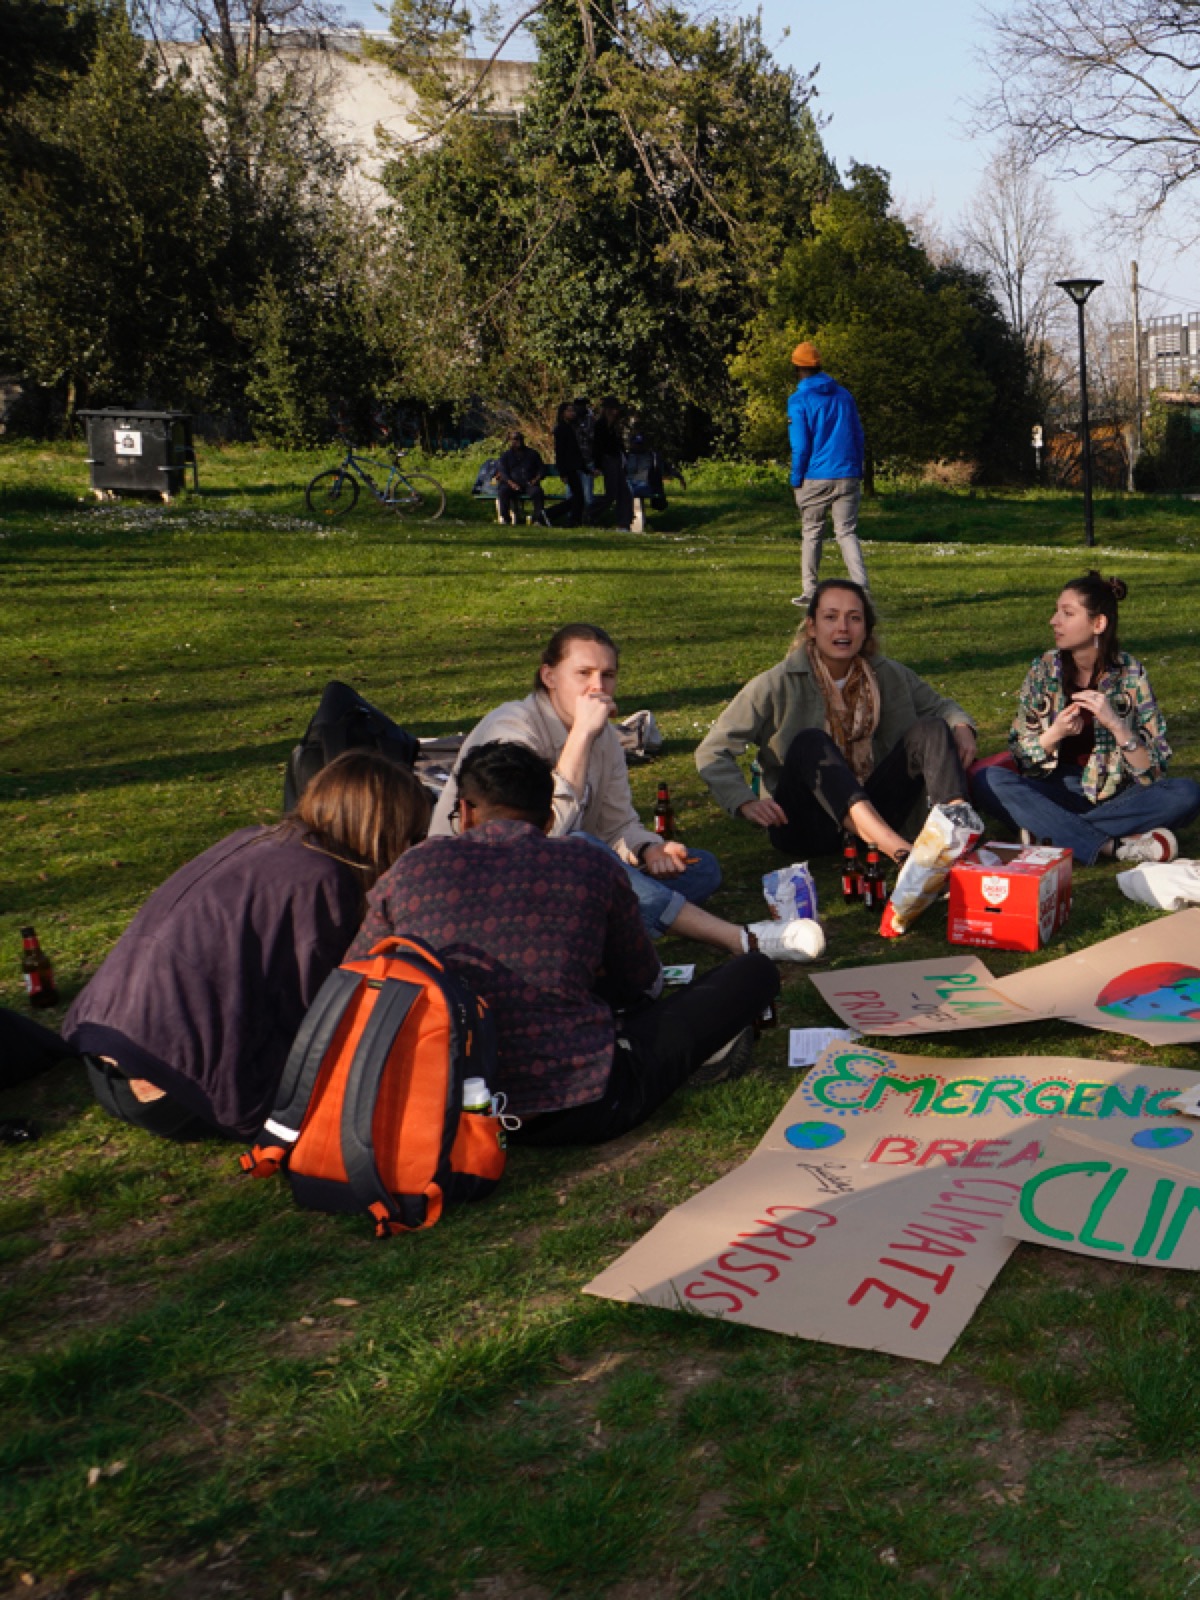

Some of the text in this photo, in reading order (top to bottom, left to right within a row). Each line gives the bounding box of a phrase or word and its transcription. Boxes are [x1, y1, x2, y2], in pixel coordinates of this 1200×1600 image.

[811, 1052, 1184, 1118] EMERGENC
[868, 1135, 1043, 1169] BREA
[684, 1205, 838, 1313] CRISIS
[847, 1179, 1022, 1331] CLIMATE
